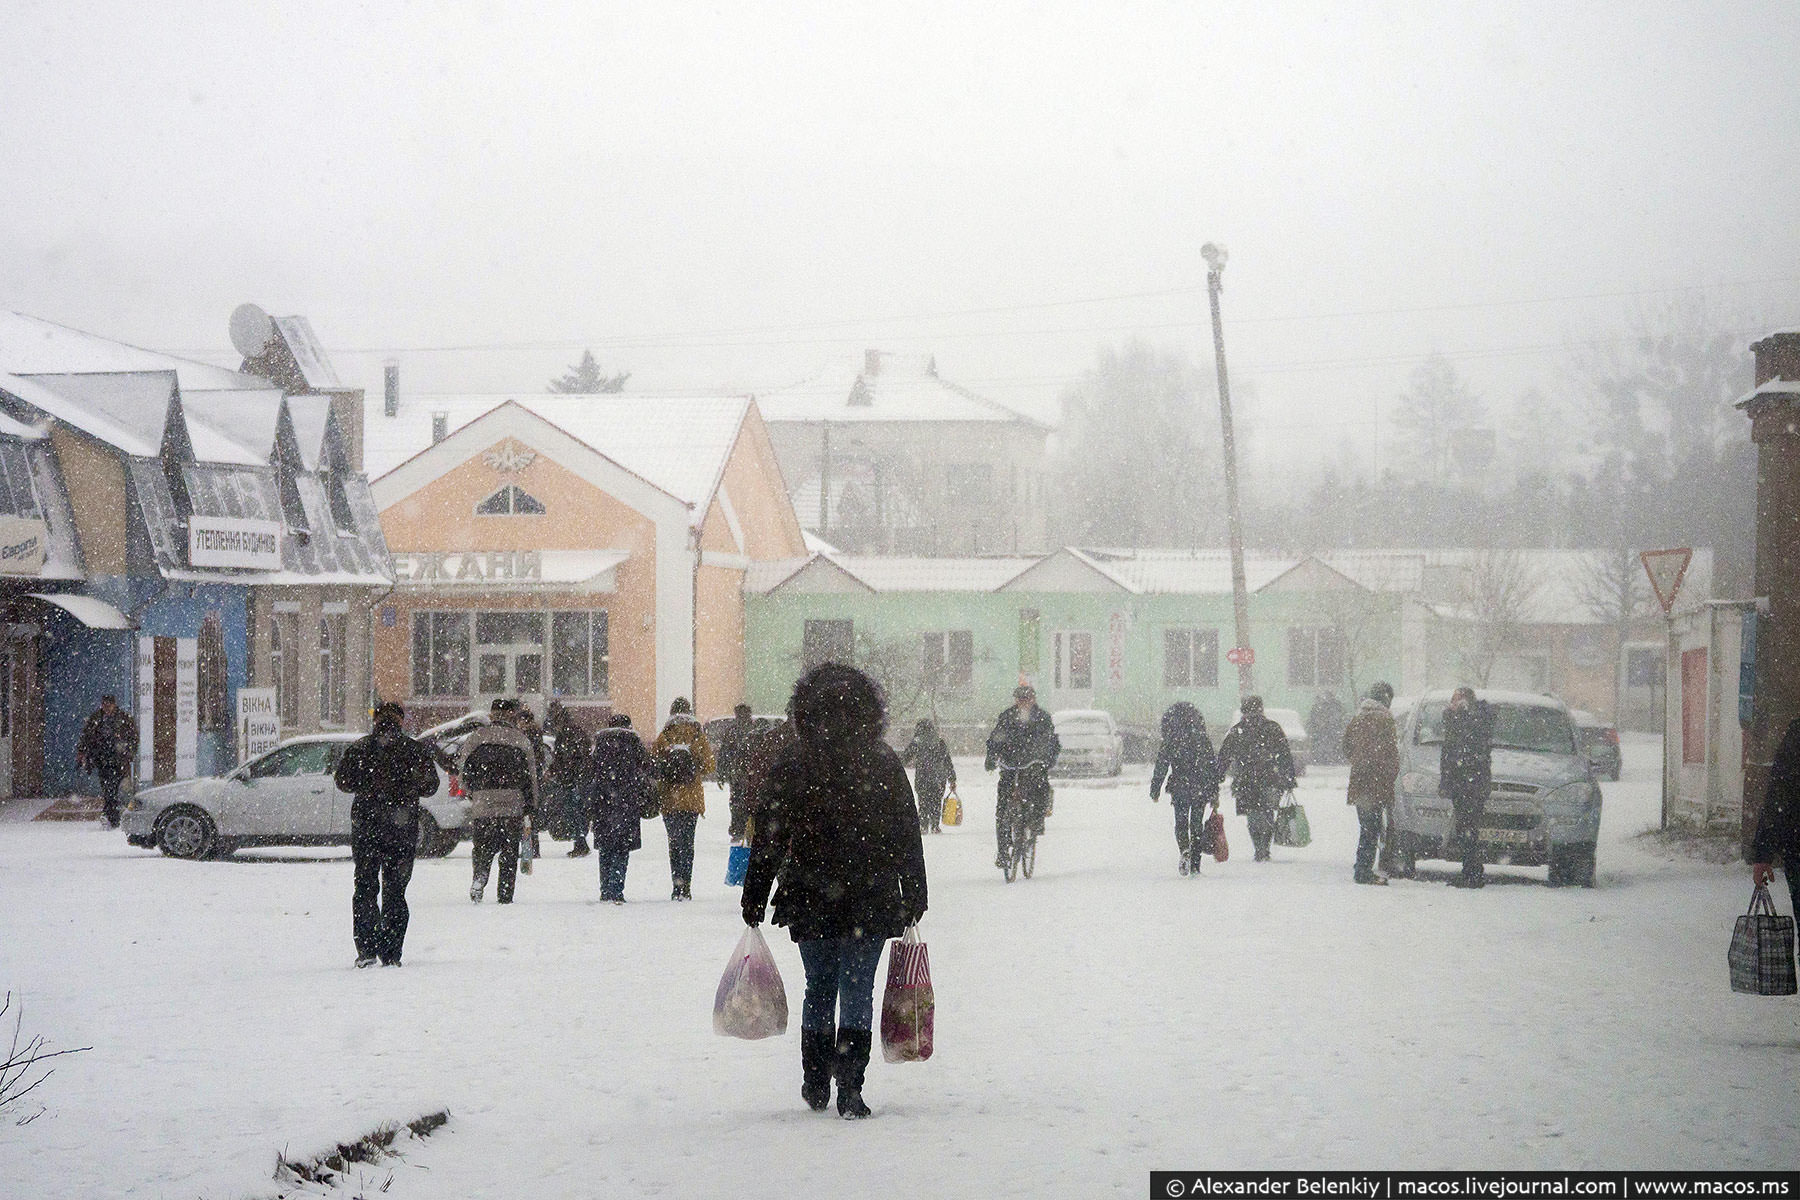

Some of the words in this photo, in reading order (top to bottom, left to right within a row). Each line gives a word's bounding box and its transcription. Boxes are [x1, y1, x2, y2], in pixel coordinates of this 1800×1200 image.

[392, 551, 541, 579] ЕЖАНИ
[242, 697, 272, 713] ВІКНА
[250, 723, 277, 736] ВІКНА
